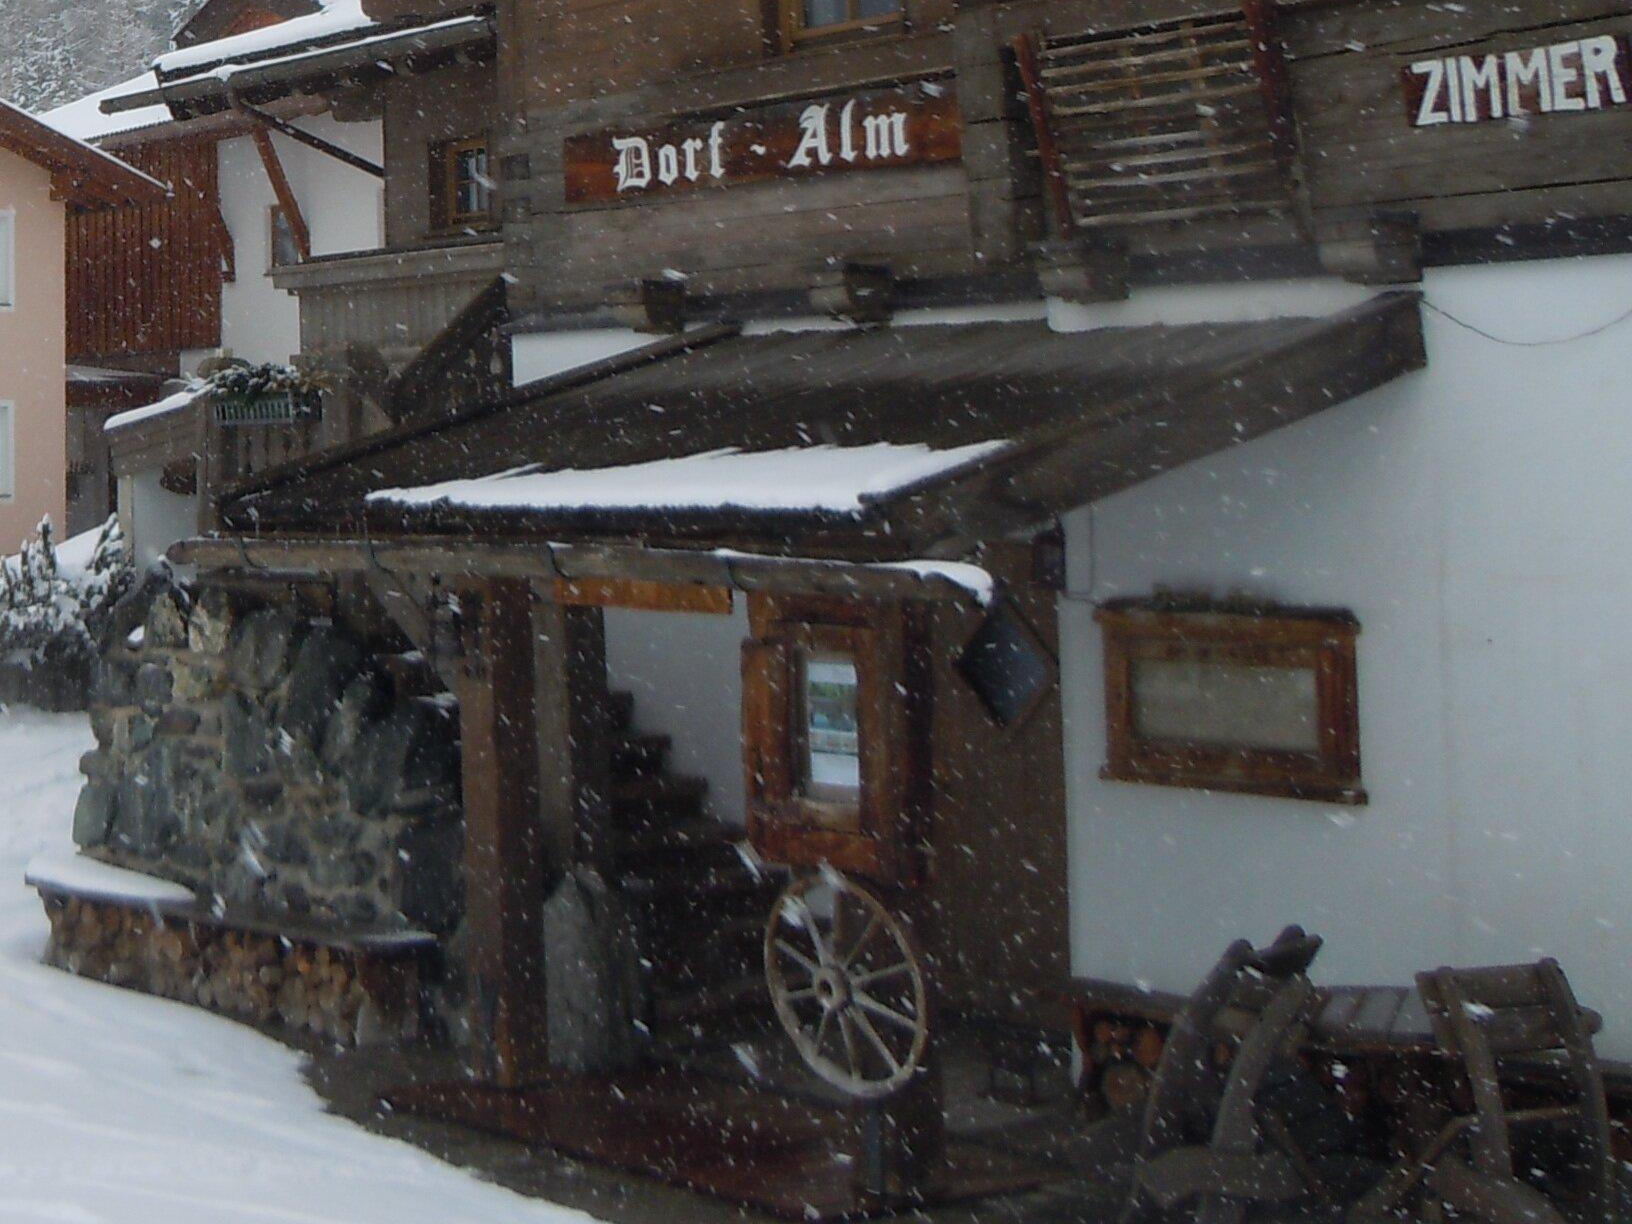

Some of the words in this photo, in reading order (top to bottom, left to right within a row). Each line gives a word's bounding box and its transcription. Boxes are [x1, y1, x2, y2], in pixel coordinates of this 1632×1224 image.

[1411, 35, 1627, 126] ZIMMER
[613, 121, 725, 192] Dorf
[788, 98, 909, 168] Alm
